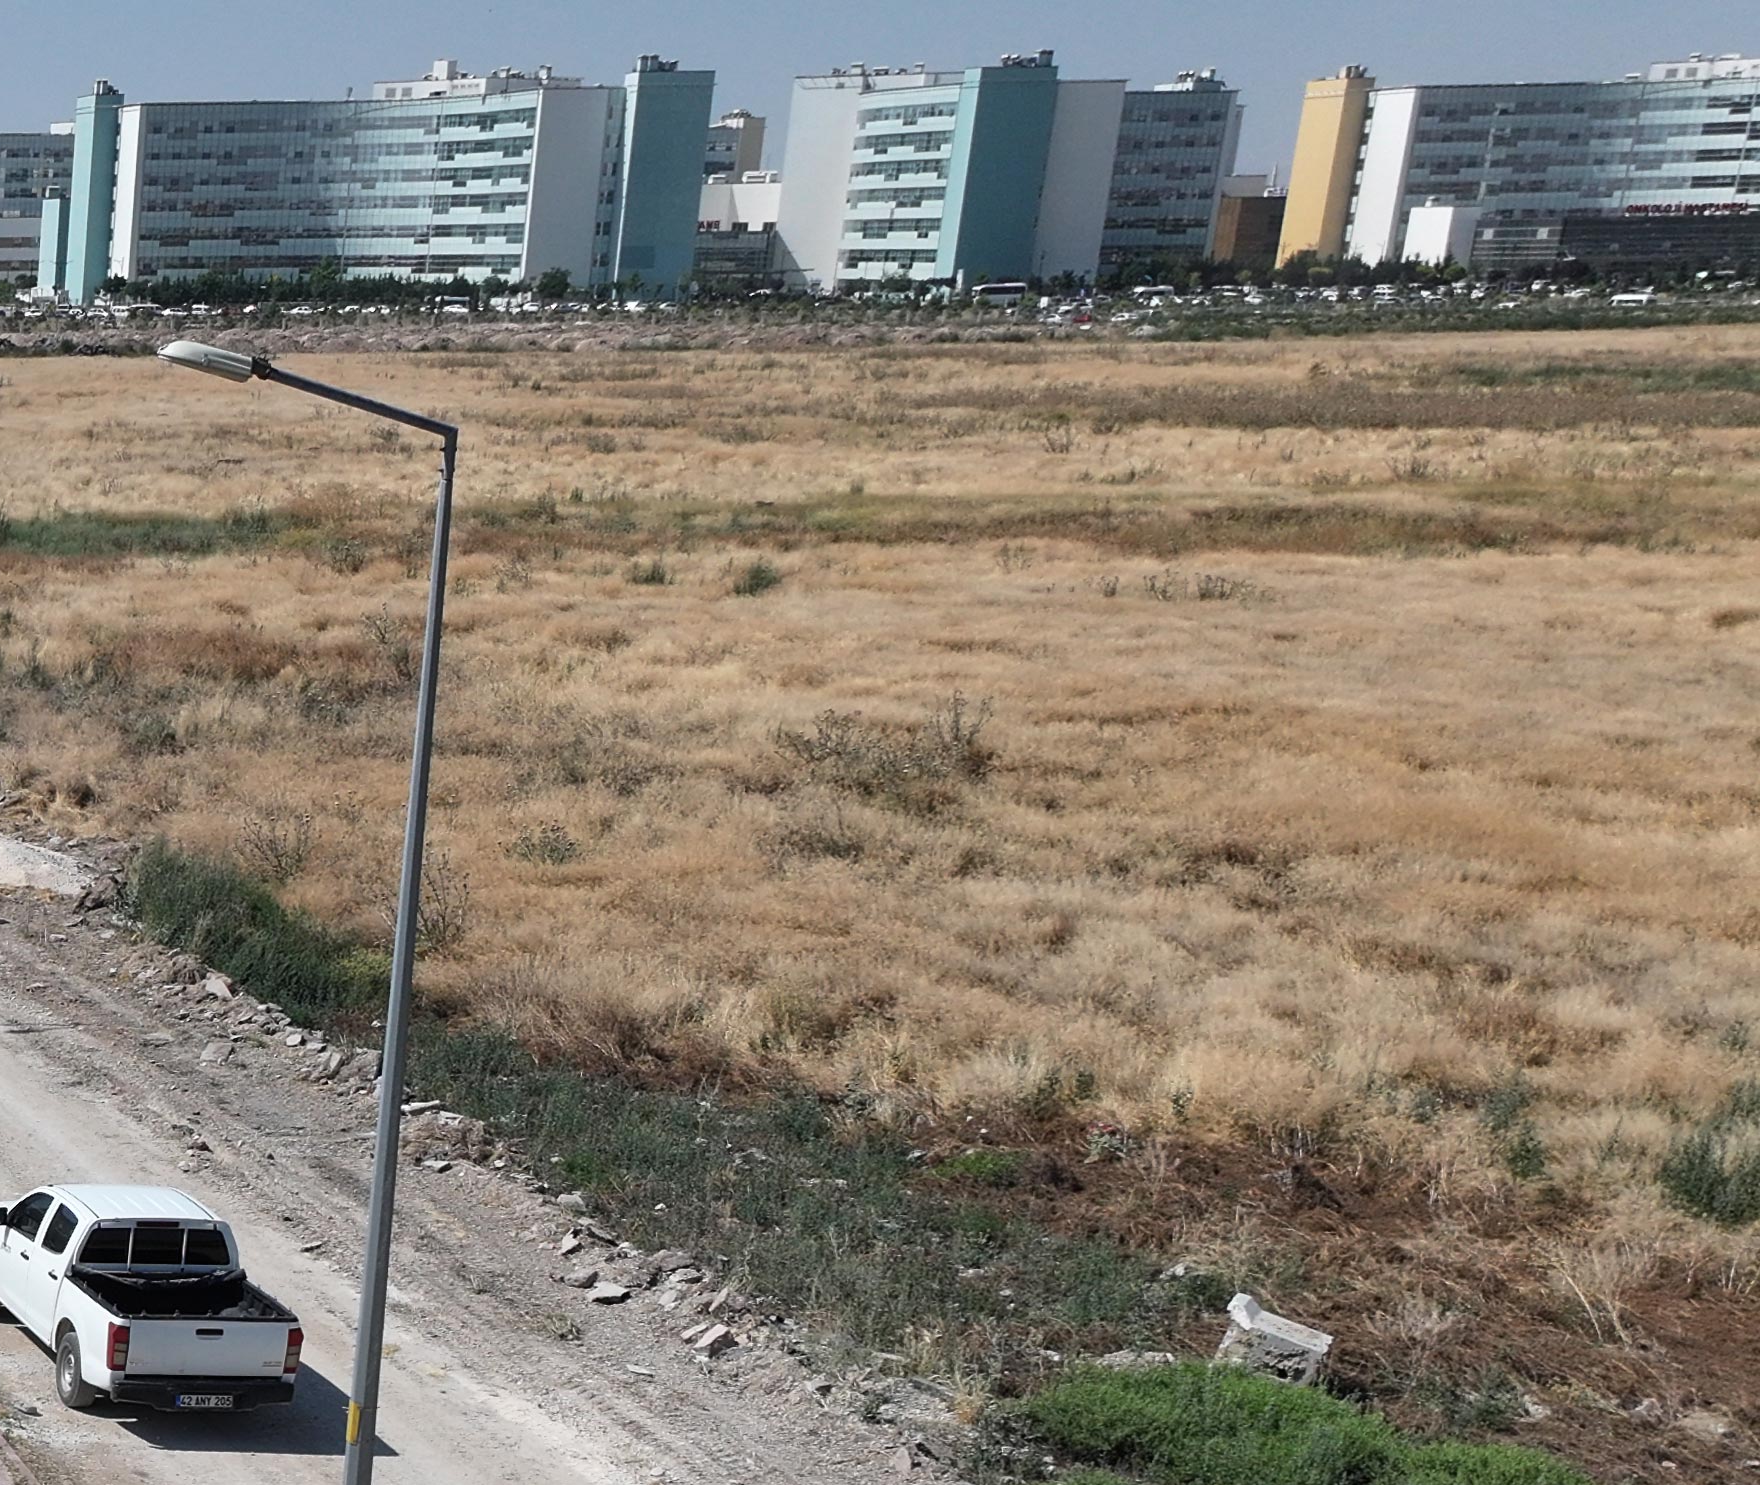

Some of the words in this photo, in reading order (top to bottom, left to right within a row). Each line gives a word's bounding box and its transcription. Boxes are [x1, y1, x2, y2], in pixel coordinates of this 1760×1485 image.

[180, 1396, 192, 1406] 42
[194, 1396, 212, 1406] ANY
[215, 1396, 232, 1406] 205
